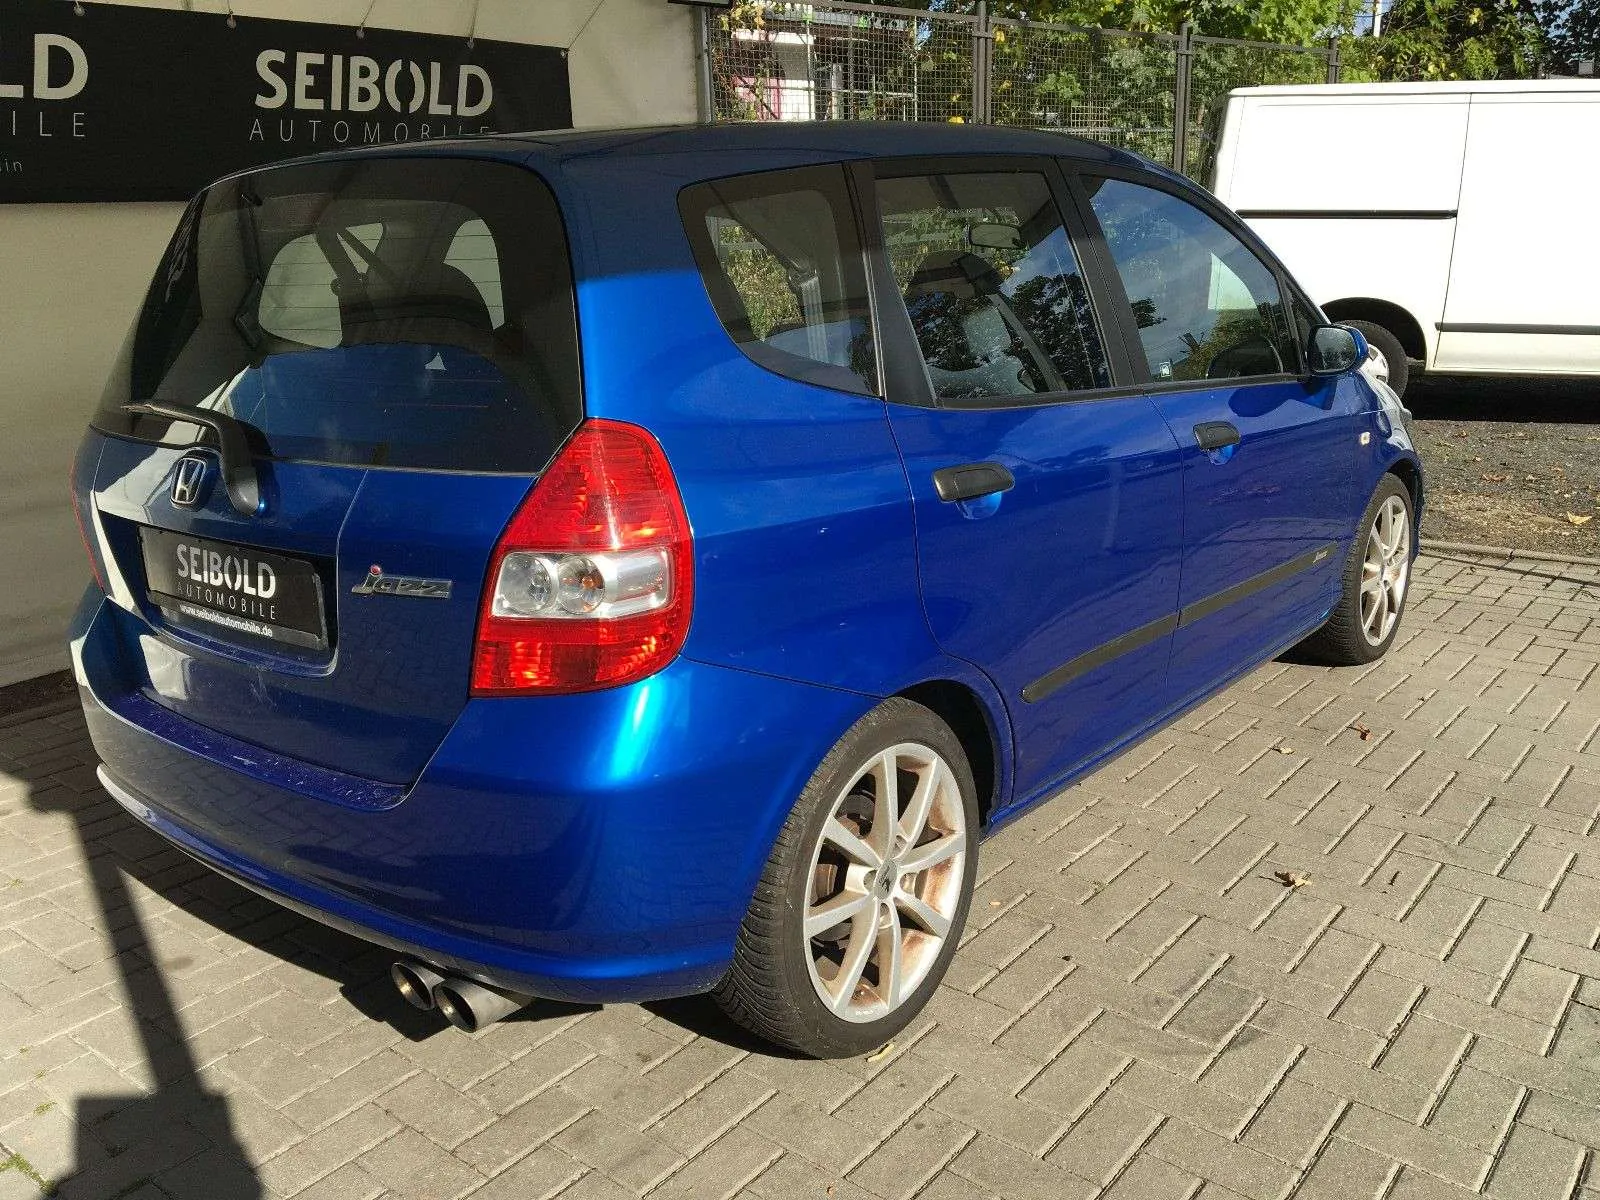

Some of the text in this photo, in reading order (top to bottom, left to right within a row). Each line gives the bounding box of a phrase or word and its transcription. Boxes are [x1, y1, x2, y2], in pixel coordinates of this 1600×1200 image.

[255, 49, 493, 117] SEIBOLD
[249, 118, 489, 142] AUTOMOBI
[177, 543, 276, 599] SEIBOLD
[177, 580, 276, 620] AUTOMOBILE
[180, 604, 272, 637] www.seiboldautomobile.de
